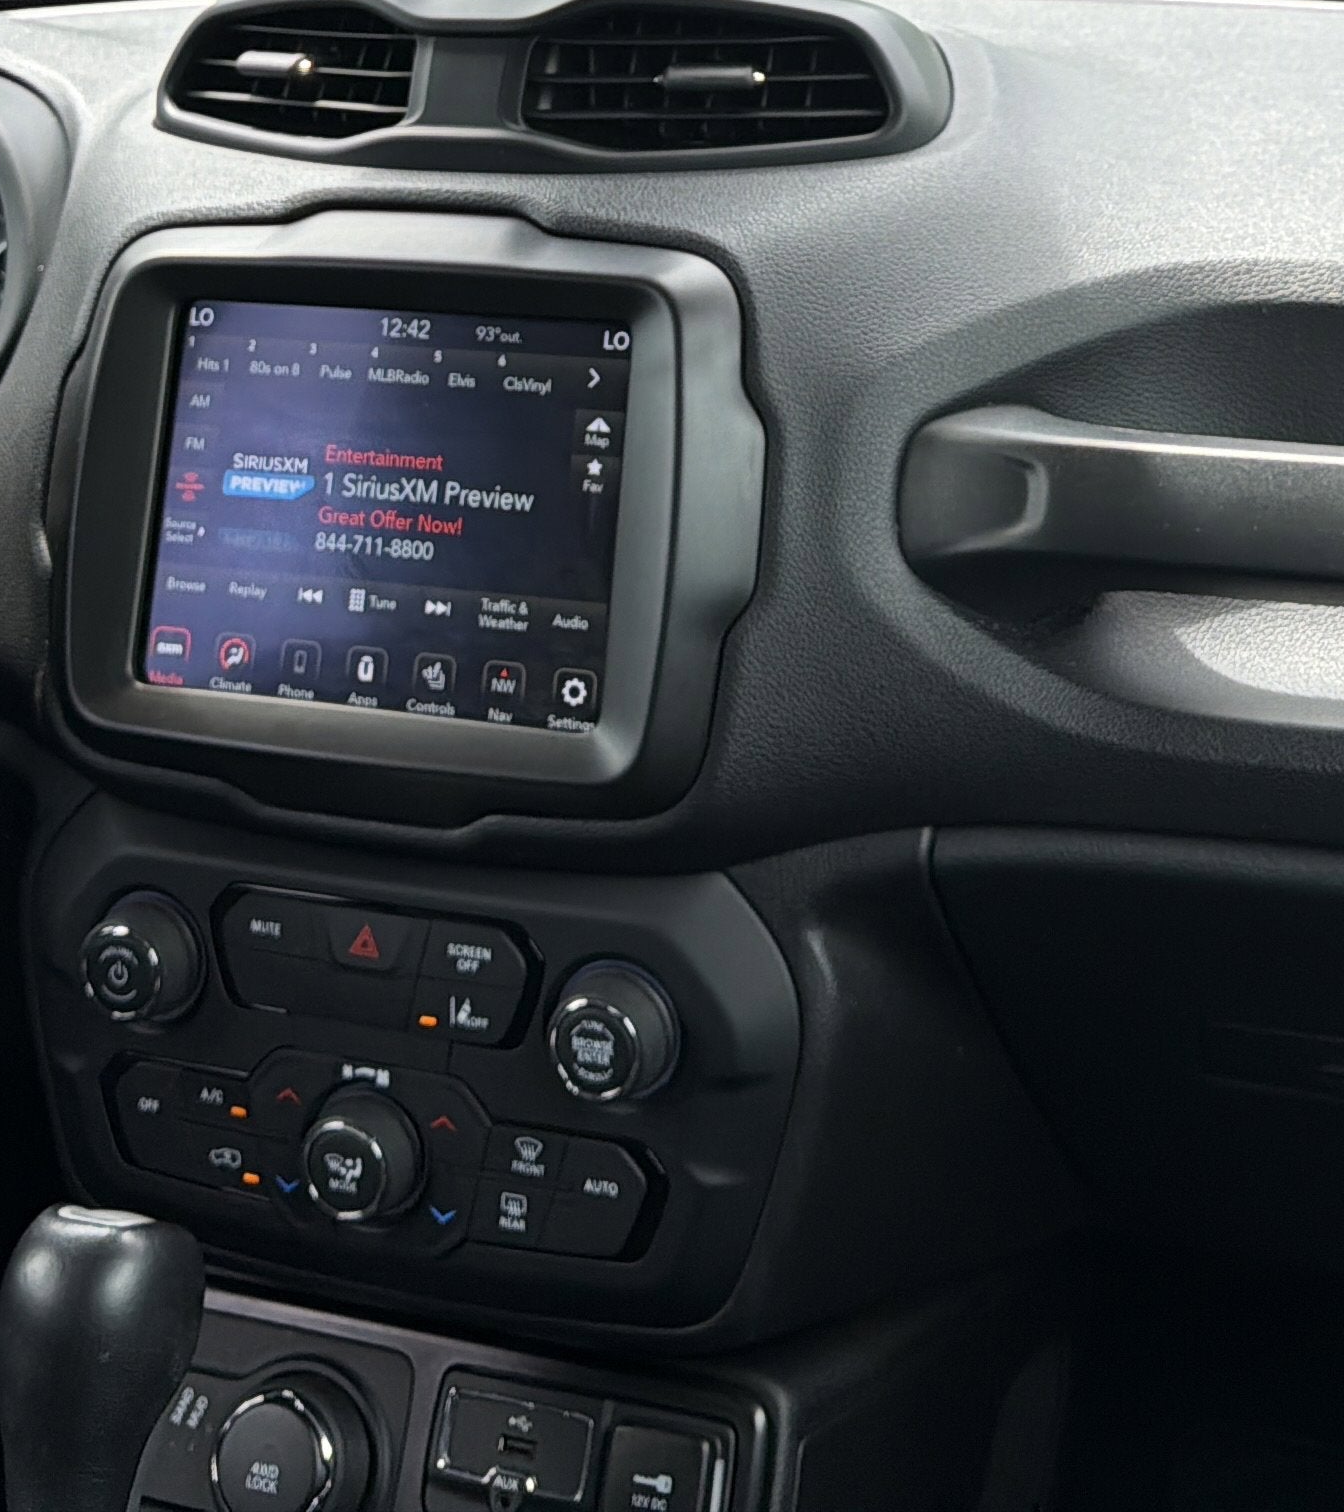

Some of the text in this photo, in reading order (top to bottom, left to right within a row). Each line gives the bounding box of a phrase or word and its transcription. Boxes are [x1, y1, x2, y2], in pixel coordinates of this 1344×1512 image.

[189, 307, 215, 327] LO
[380, 317, 431, 339] 12:42
[248, 339, 256, 352] 2
[309, 343, 317, 355] 3
[603, 330, 630, 351] LO
[371, 346, 379, 358] 4
[434, 350, 442, 363] 5
[197, 357, 229, 372] Hits 1
[274, 364, 289, 375] on
[320, 365, 352, 379] Pulse
[368, 367, 430, 385] MLBRadio
[447, 373, 476, 387] Elvis
[189, 394, 210, 408] AM
[185, 437, 204, 450] FM
[584, 434, 609, 449] Map
[324, 444, 444, 472] Entertainment
[230, 475, 307, 494] PREVIEW
[324, 472, 535, 512] 1 SiriusXM Preview
[582, 479, 603, 494] Fav
[165, 516, 196, 530] Source
[318, 505, 464, 536] Great Offer Now!
[165, 530, 194, 543] Select
[314, 531, 434, 561] 844-711-8800
[167, 576, 206, 593] Browse
[229, 581, 267, 601] Replay
[369, 594, 397, 610] Tune
[481, 597, 528, 616] Traffic &
[478, 613, 529, 632] Weather
[553, 613, 589, 631] Audio
[209, 675, 252, 693] Climate
[278, 683, 315, 701] Phone
[491, 677, 516, 695] NW
[347, 691, 378, 708] Apps
[406, 697, 456, 716] Controls
[488, 708, 513, 724] Nav
[249, 918, 282, 937] MUTE
[447, 942, 492, 961] SCREEN
[456, 959, 480, 973] OFF
[200, 1087, 224, 1106] A/C
[583, 1177, 619, 1199] AUTO
